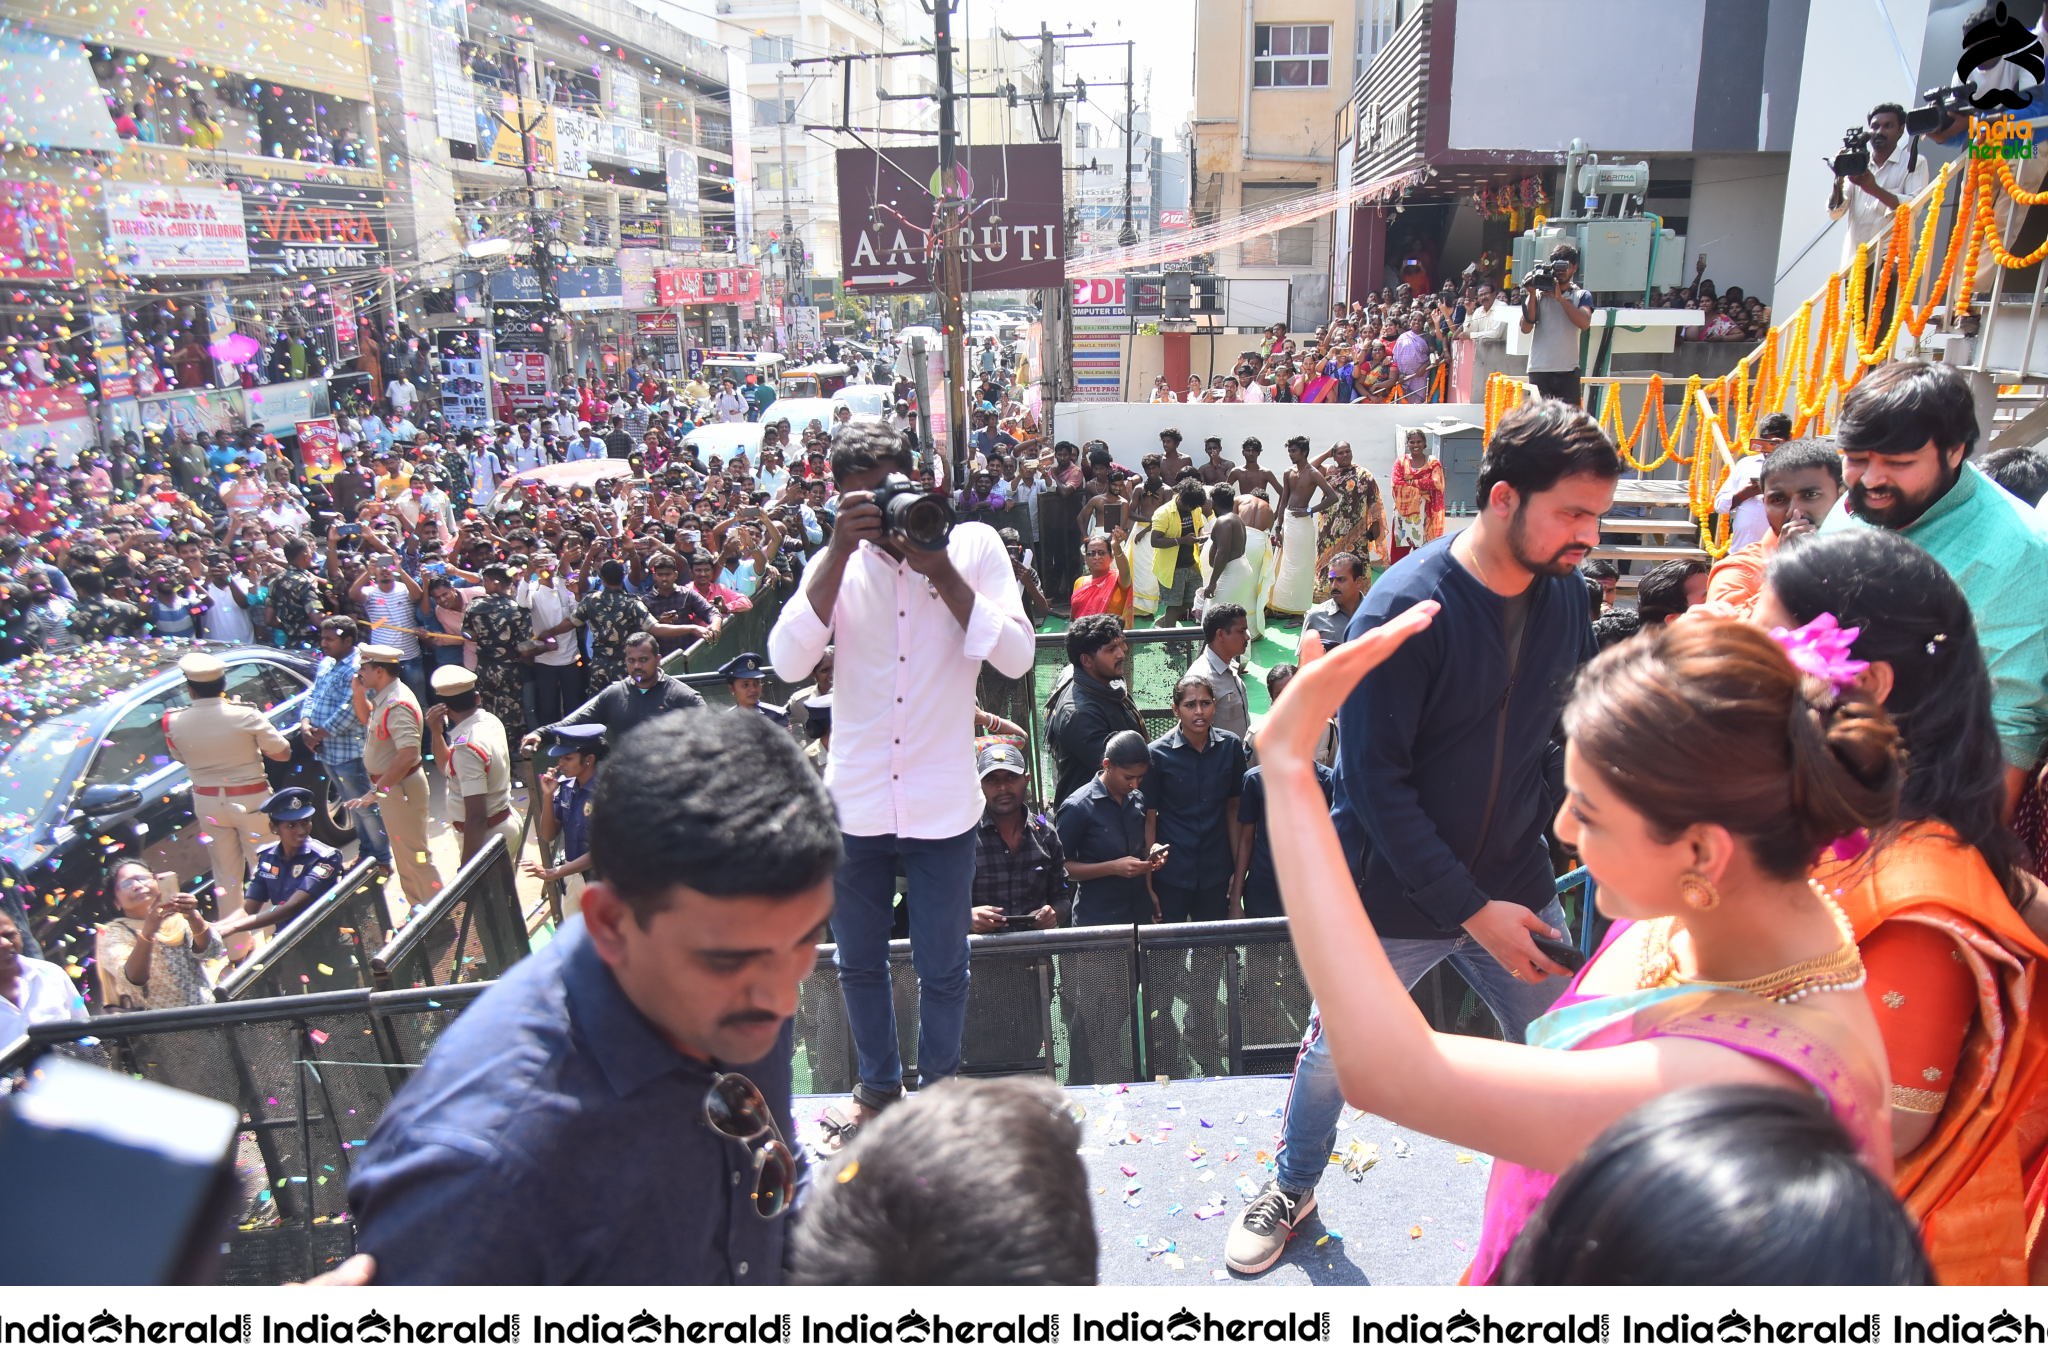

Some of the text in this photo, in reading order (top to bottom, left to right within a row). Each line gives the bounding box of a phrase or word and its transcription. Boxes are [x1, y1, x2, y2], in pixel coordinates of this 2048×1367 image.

[199, 222, 244, 239] TAILORING
[256, 197, 379, 244] VASTRA
[285, 248, 368, 272] FASHIONS
[1072, 307, 1110, 315] OMPUTER
